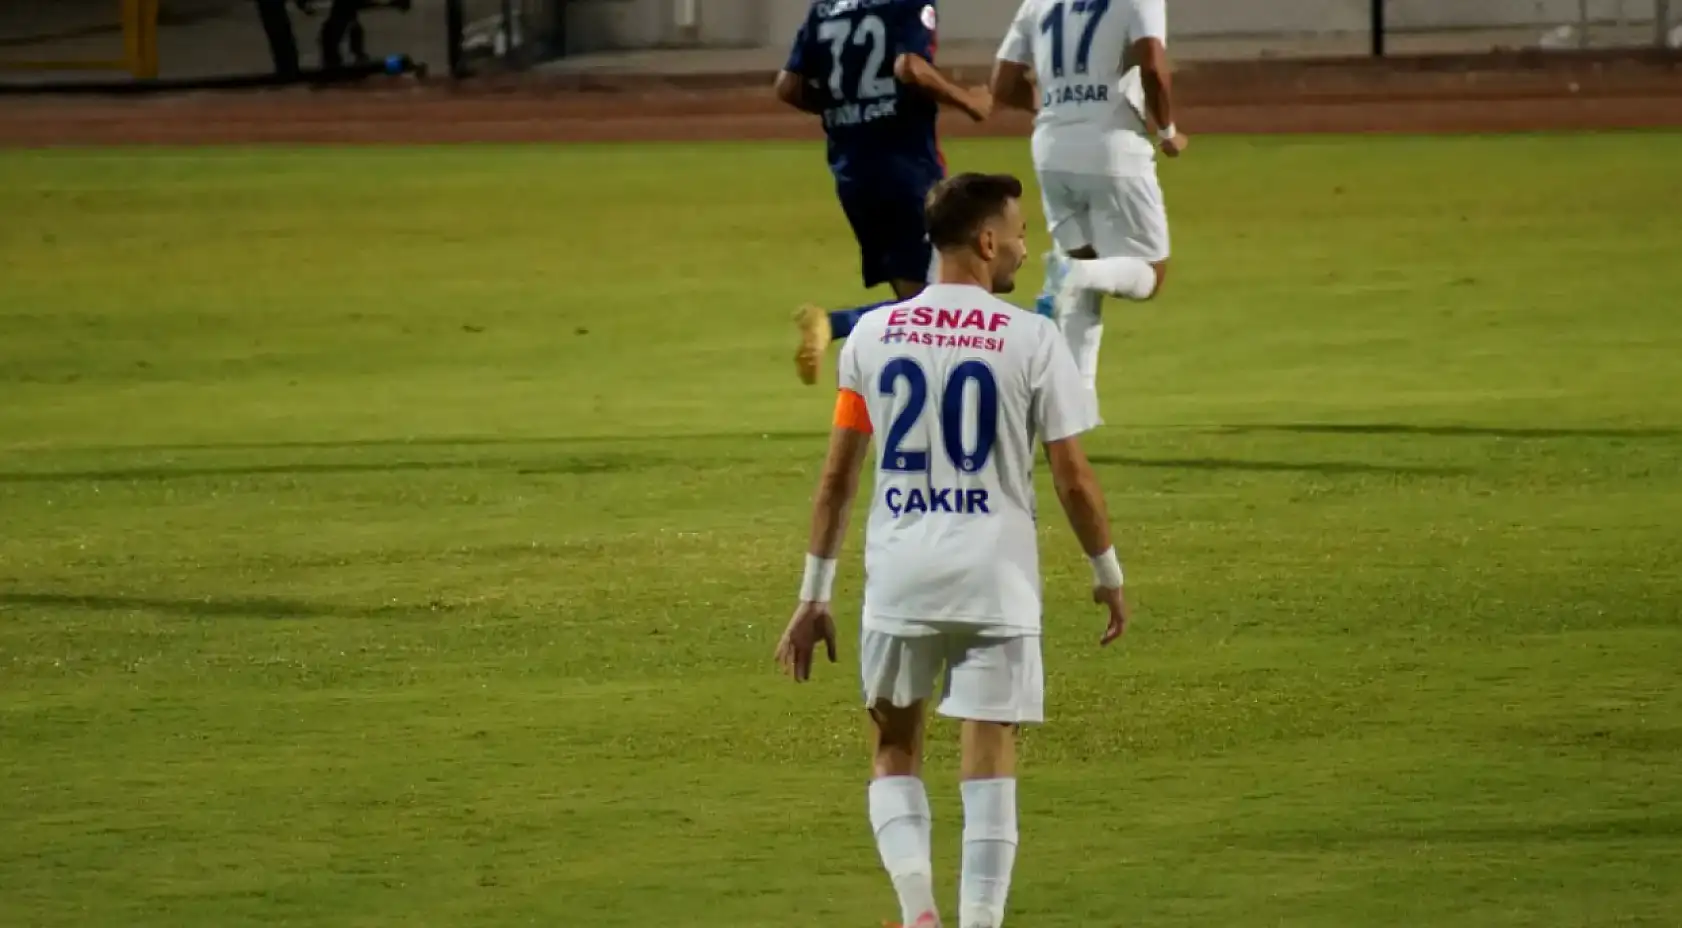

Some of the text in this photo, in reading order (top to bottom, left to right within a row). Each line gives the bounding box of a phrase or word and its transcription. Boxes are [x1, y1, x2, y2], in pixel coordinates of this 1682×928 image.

[817, 14, 896, 99] 72
[1040, 0, 1110, 77] 17
[880, 326, 1005, 353] HASTANESİ
[887, 306, 1011, 332] ESNAF
[879, 357, 998, 473] 20
[885, 487, 990, 518] ÇAKIR
